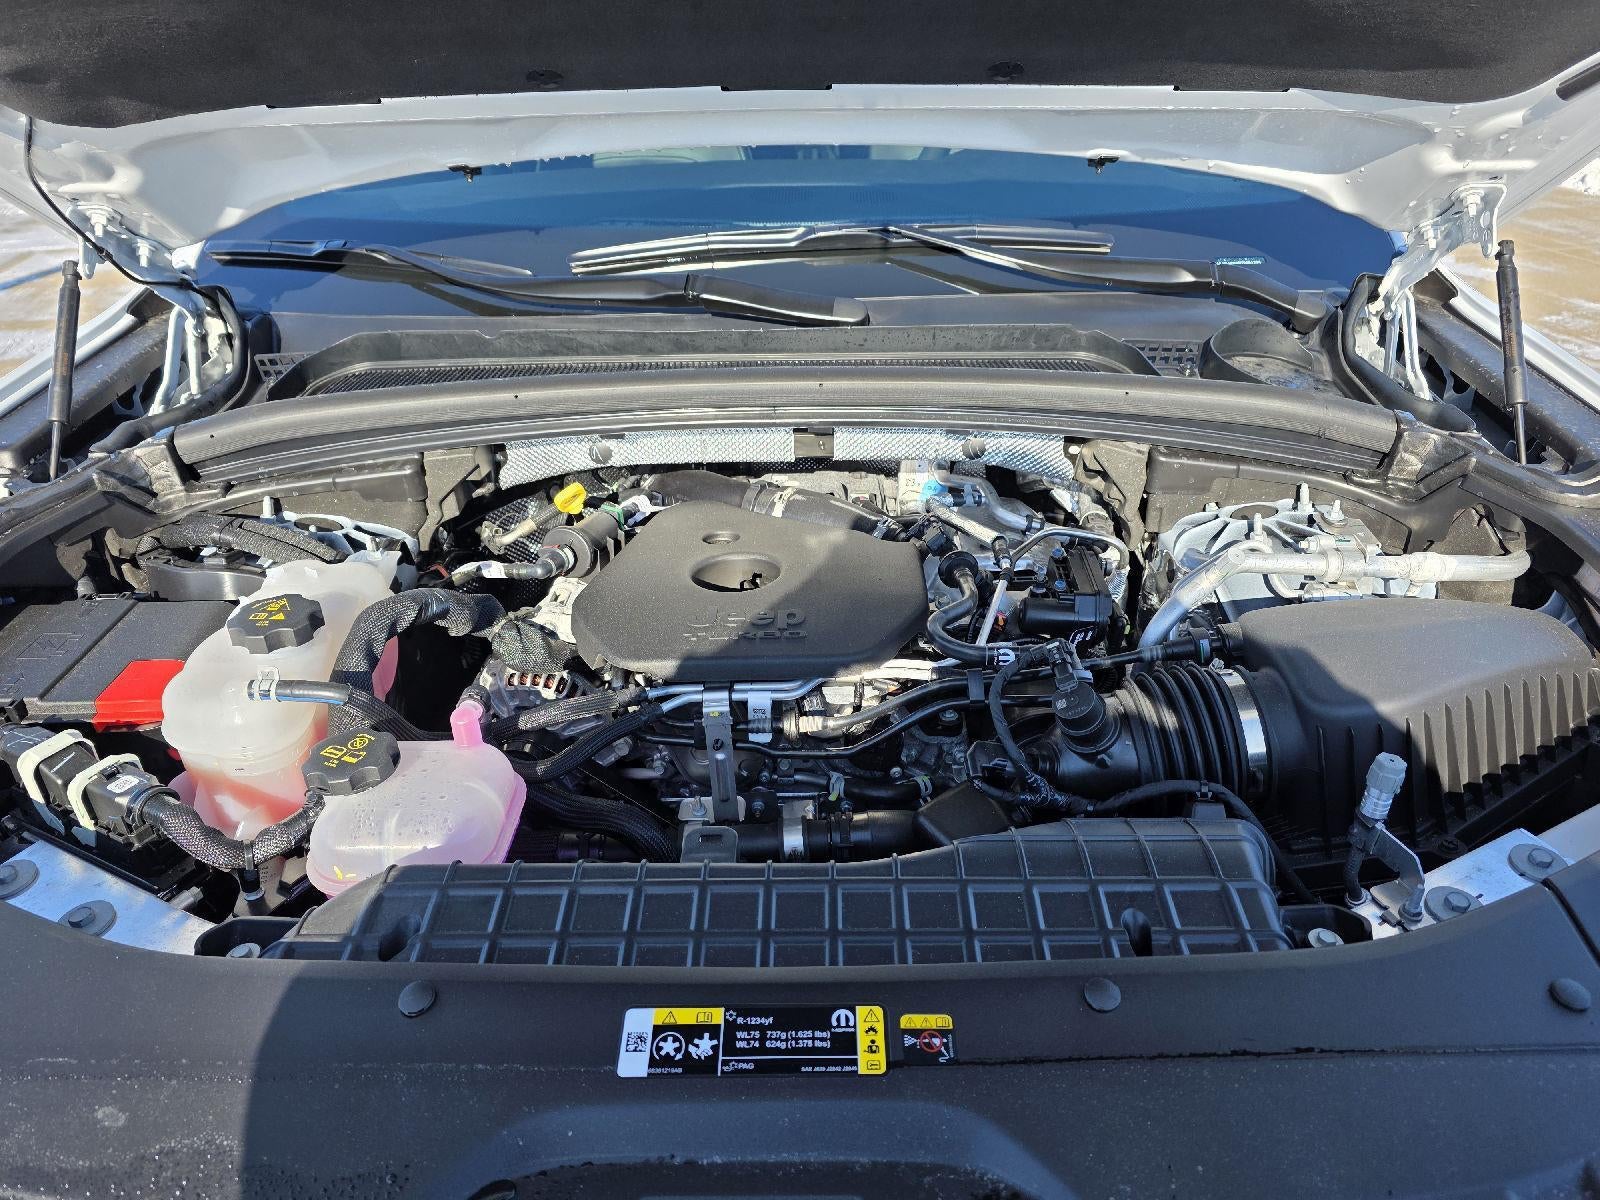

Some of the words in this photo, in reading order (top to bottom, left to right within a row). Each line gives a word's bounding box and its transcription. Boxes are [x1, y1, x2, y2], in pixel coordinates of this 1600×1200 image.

[736, 1016, 774, 1026] R-1234yf
[735, 1031, 760, 1039] WL75
[766, 1031, 787, 1040] 737g
[814, 1030, 831, 1039] lbs)
[735, 1040, 760, 1049] WL74
[765, 1040, 787, 1049] 624g
[814, 1040, 831, 1049] lbs)
[739, 1062, 755, 1070] PAG
